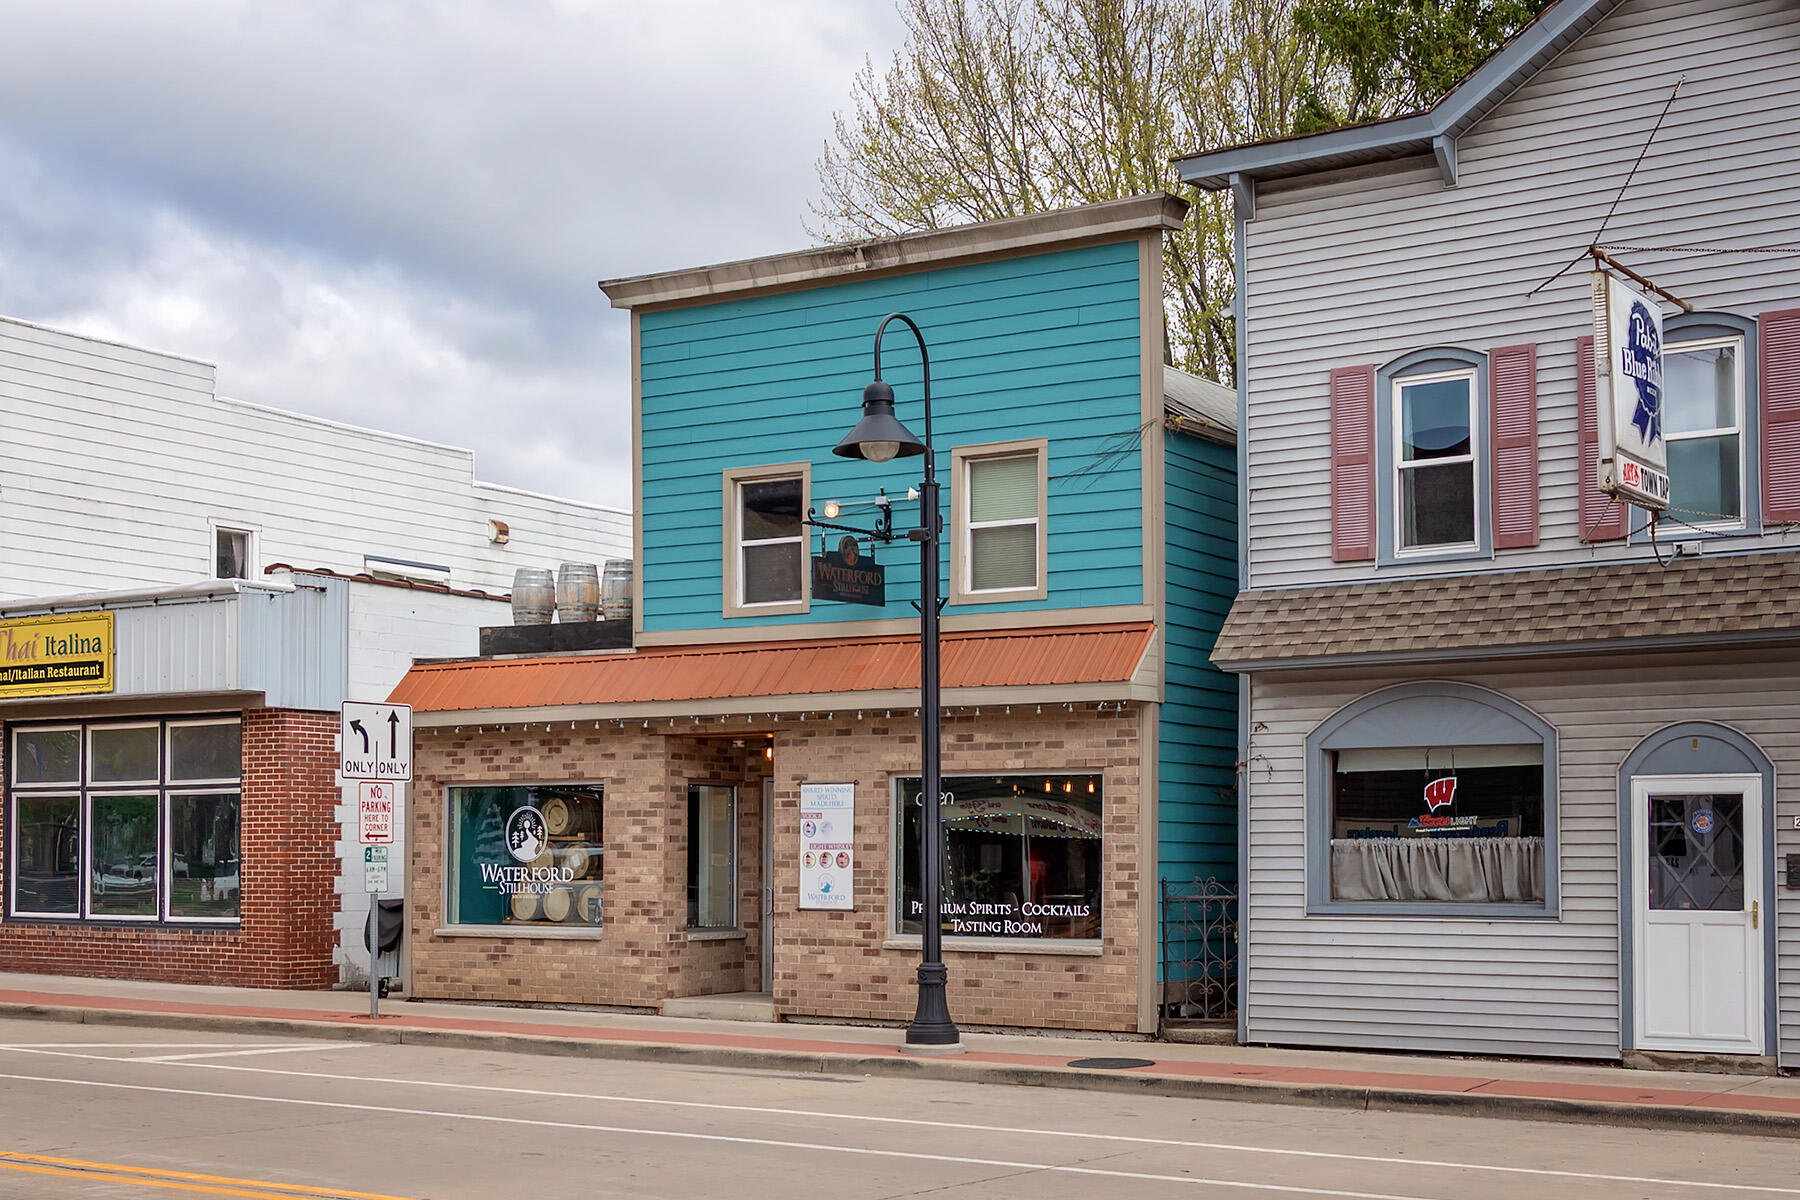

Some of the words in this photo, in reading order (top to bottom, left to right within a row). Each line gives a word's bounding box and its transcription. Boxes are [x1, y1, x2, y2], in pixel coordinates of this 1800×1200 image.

[1622, 348, 1647, 380] Blue
[1641, 468, 1658, 496] TOWN
[1658, 475, 1669, 500] TAP
[817, 562, 882, 586] WATERFORD
[45, 633, 102, 656] Italina
[47, 664, 100, 678] Restaurant
[345, 760, 374, 773] ONLY
[379, 762, 407, 774] ONLY
[370, 787, 383, 799] NO
[1424, 776, 1457, 813] W
[361, 801, 391, 813] PARKING
[364, 814, 379, 823] HERE
[381, 814, 389, 823] TO
[1450, 815, 1478, 827] LIGHT
[365, 823, 388, 832] CORNER
[366, 850, 372, 860] 2
[480, 864, 574, 882] WATERFORD
[499, 881, 554, 894] STILLHOUSE
[969, 901, 1011, 916] SPIRITS
[1021, 902, 1090, 917] COCKTAILS
[951, 919, 1001, 934] TASTING
[1004, 919, 1042, 934] ROOM
